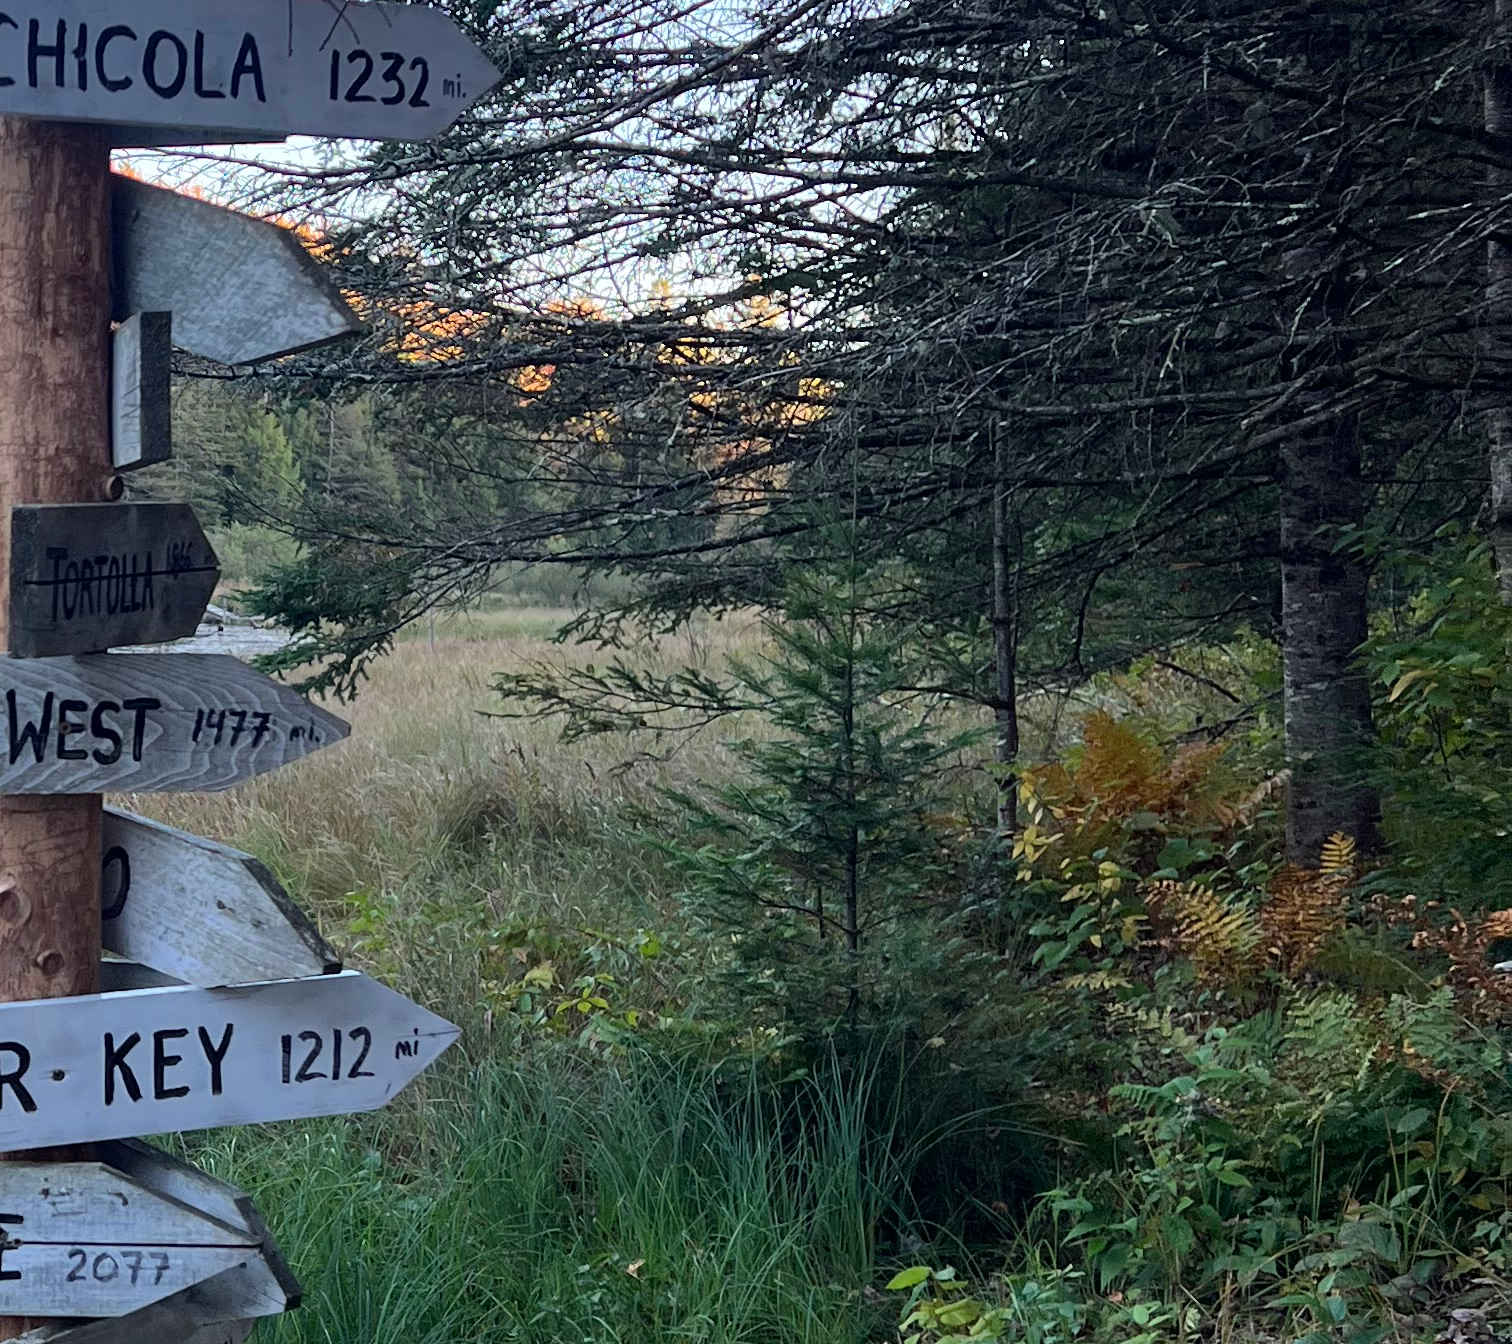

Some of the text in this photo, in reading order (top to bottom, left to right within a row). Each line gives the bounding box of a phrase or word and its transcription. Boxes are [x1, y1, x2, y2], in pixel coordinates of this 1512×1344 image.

[329, 49, 431, 108] 1232
[442, 73, 467, 98] mi.
[6, 689, 161, 765] WEST
[192, 708, 272, 748] 1477
[103, 1023, 234, 1106] KEY
[282, 1026, 376, 1085] 1212
[394, 1029, 420, 1060] mi
[65, 1247, 171, 1285] 2077
